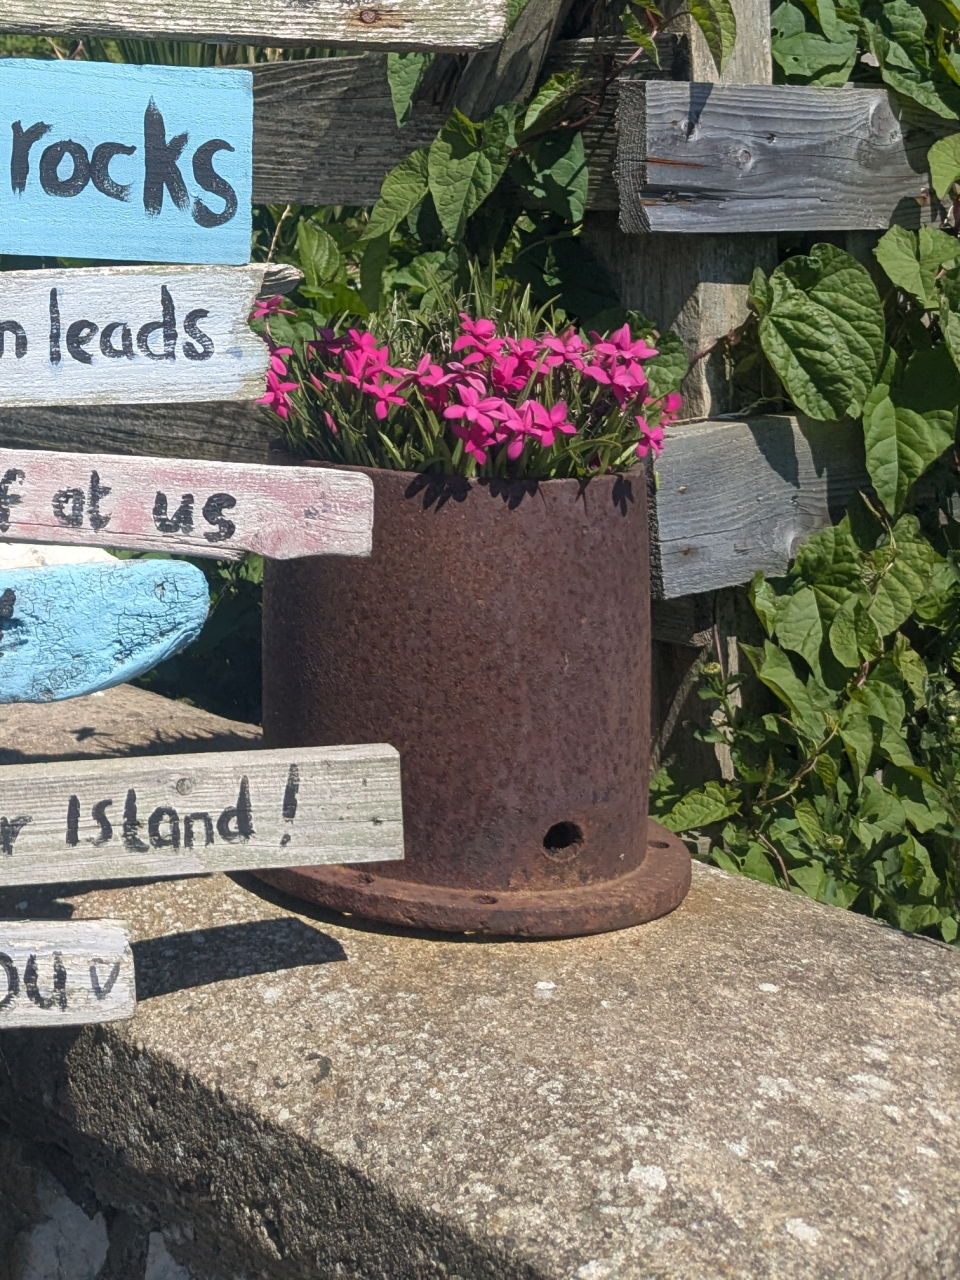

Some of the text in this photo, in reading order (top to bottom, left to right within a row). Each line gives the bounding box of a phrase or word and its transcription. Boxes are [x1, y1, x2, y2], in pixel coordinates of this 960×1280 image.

[10, 95, 239, 228] rocks
[49, 284, 216, 366] leads
[51, 470, 113, 532] at
[153, 491, 237, 543] us
